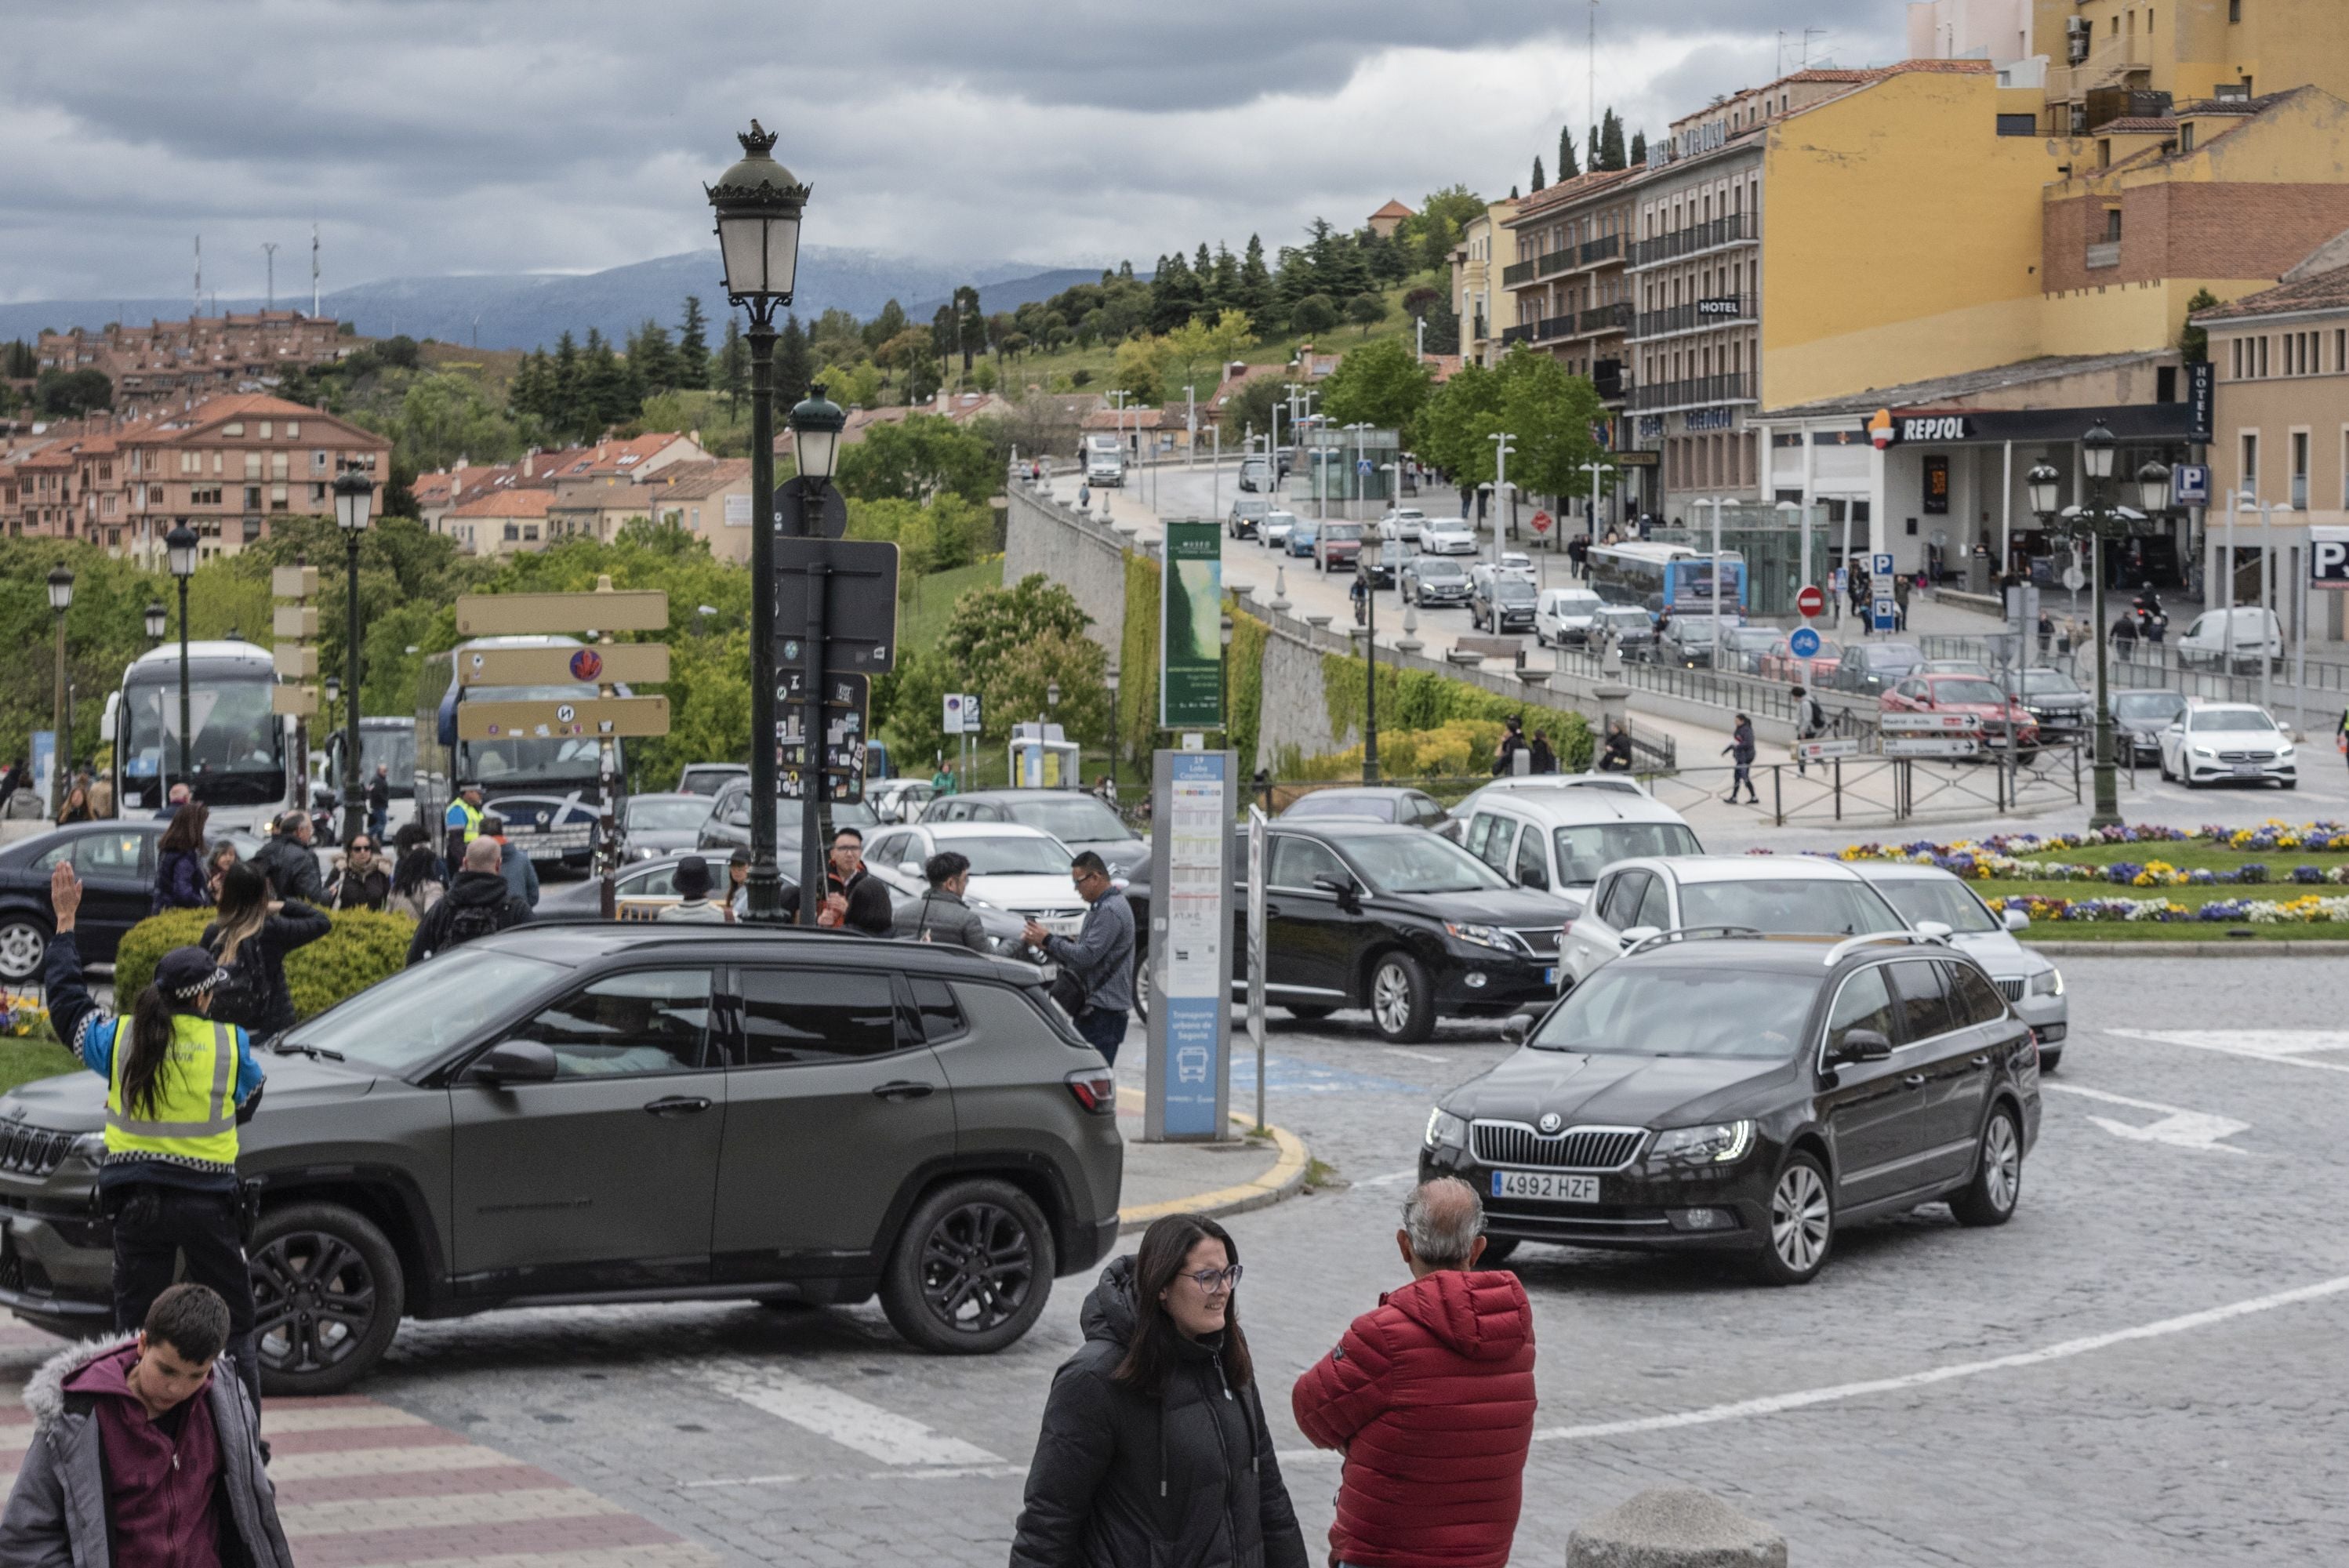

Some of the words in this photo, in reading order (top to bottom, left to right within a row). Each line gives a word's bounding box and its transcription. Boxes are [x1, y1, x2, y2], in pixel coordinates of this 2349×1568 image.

[1700, 301, 1738, 313] HOTEL
[2195, 366, 2207, 422] HOTEL
[1904, 416, 1965, 441] REPSOL
[2184, 469, 2202, 489] P
[1876, 555, 1890, 573] P
[2315, 542, 2347, 578] P
[1506, 1176, 1552, 1196] 4992
[1558, 1178, 1595, 1198] HZF
